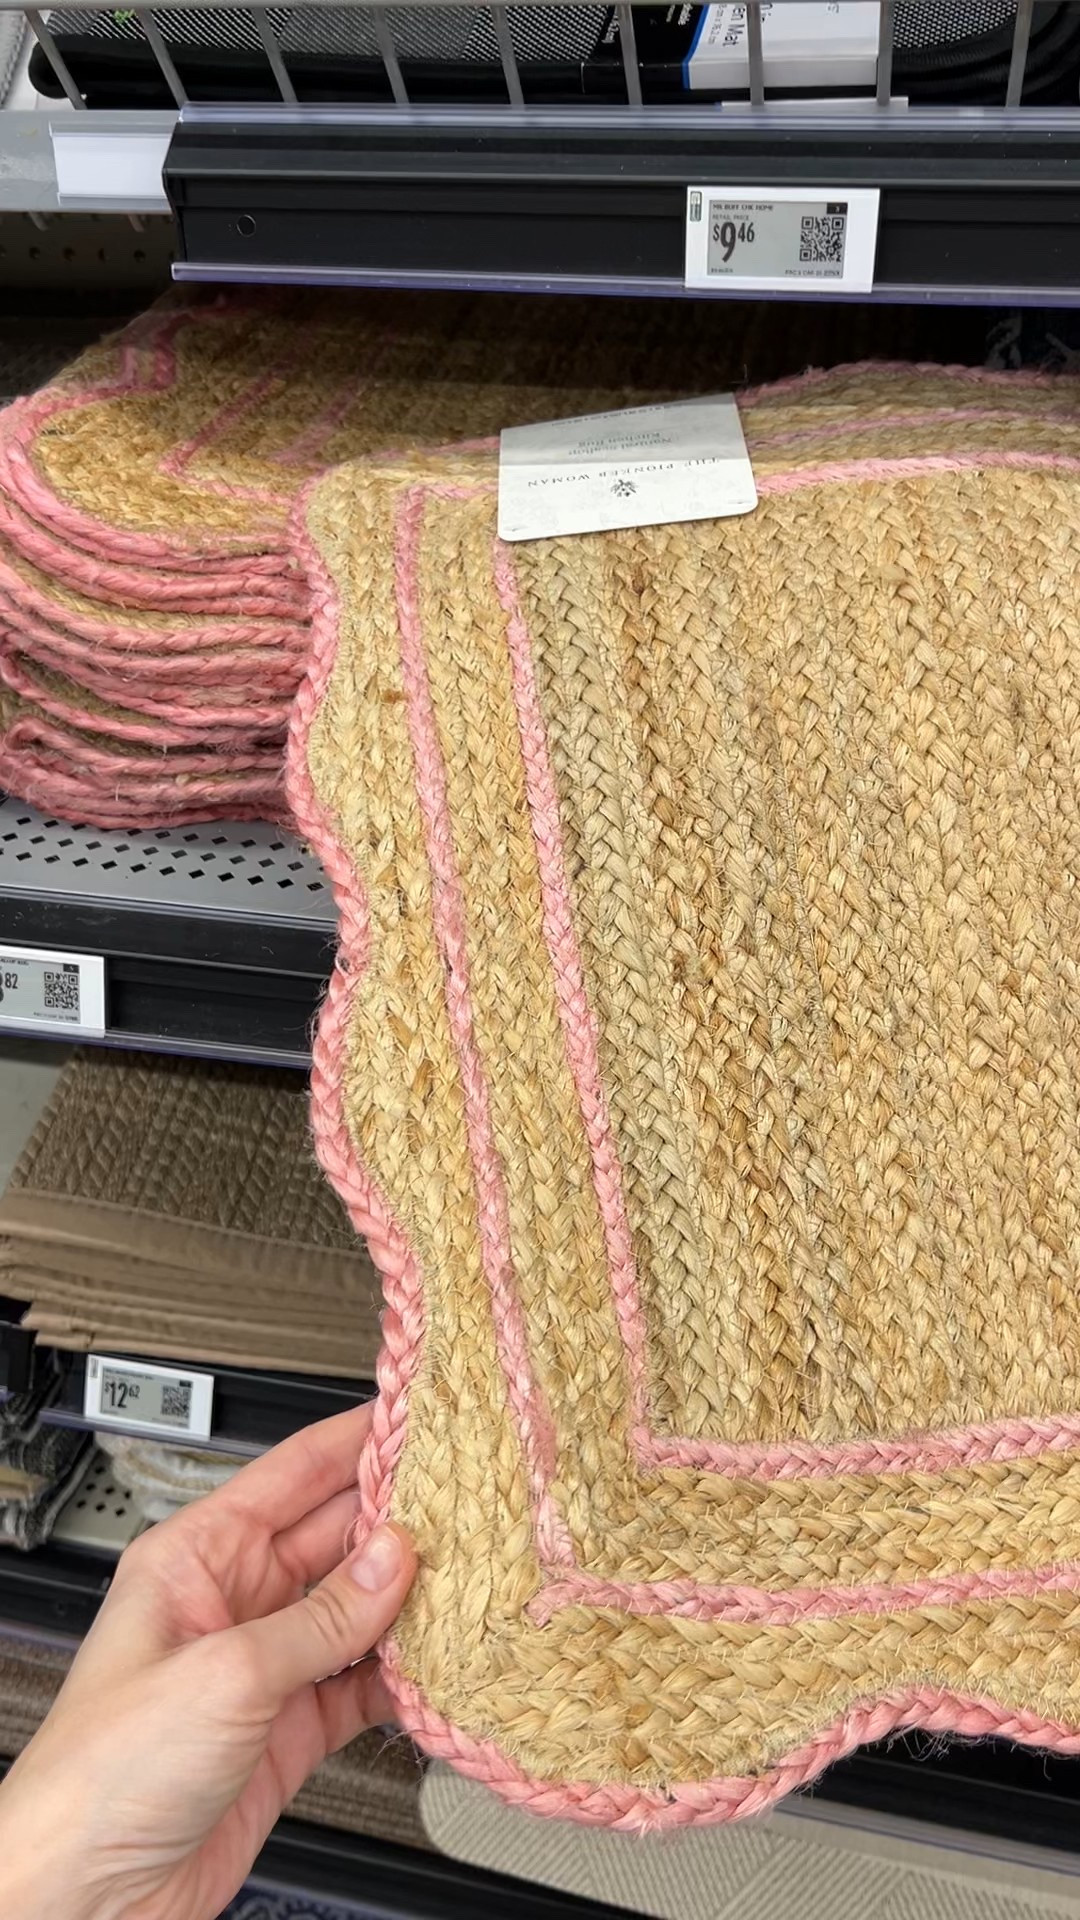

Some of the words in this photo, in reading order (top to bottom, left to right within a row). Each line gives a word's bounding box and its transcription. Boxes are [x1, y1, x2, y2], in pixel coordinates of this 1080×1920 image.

[722, 24, 746, 47] Mat
[599, 463, 675, 478] PIONEER
[527, 473, 590, 488] WOMAN
